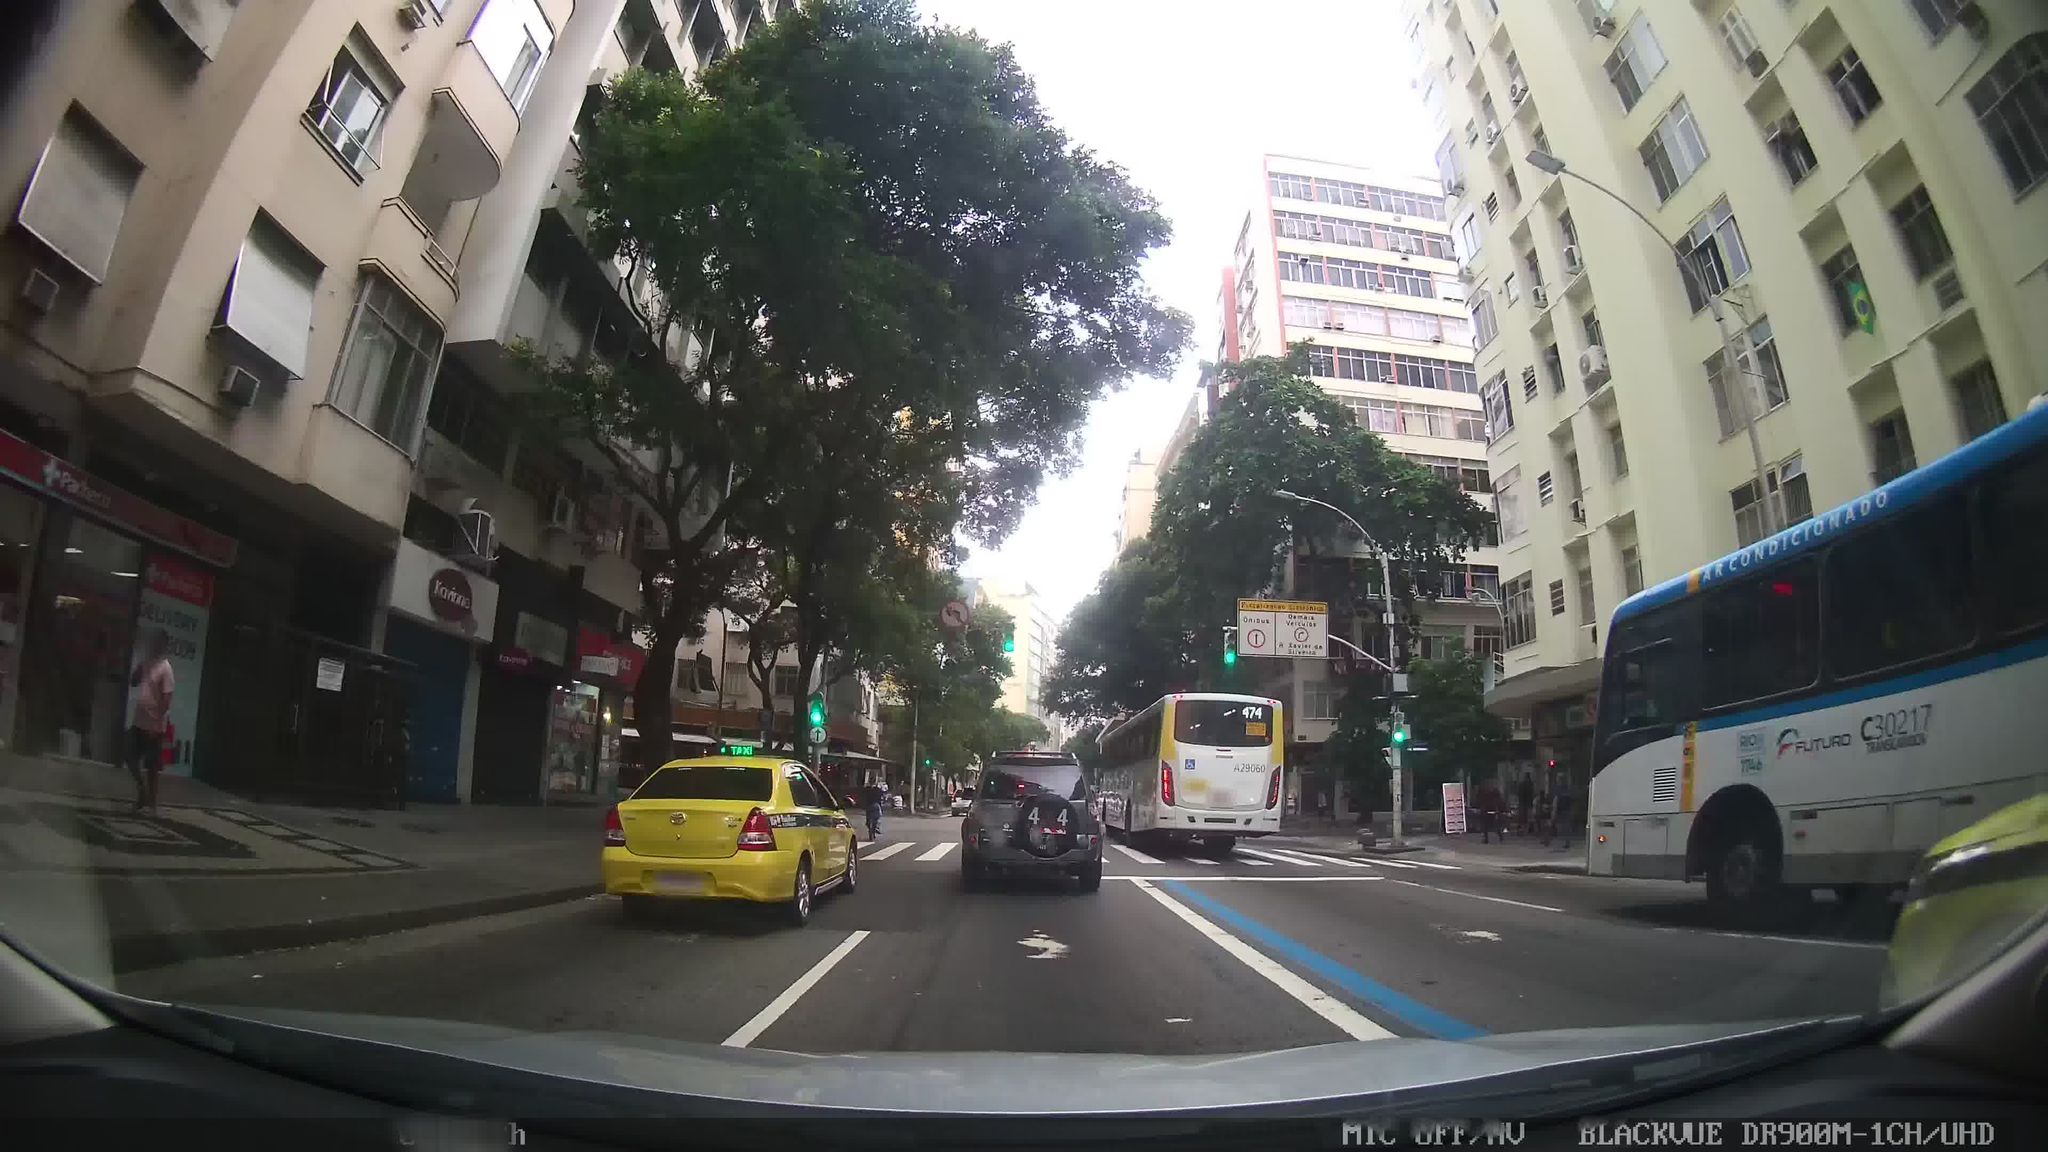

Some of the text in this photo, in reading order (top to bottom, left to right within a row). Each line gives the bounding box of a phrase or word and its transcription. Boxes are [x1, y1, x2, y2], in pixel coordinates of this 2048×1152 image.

[1702, 491, 1887, 582] AR CONDICIONADO
[1242, 706, 1262, 719] 474
[1860, 703, 1932, 741] C30217
[730, 746, 753, 755] TAXI
[1795, 733, 1852, 752] FUTURO
[1233, 763, 1266, 773] A29060
[1028, 807, 1068, 826] 4 4
